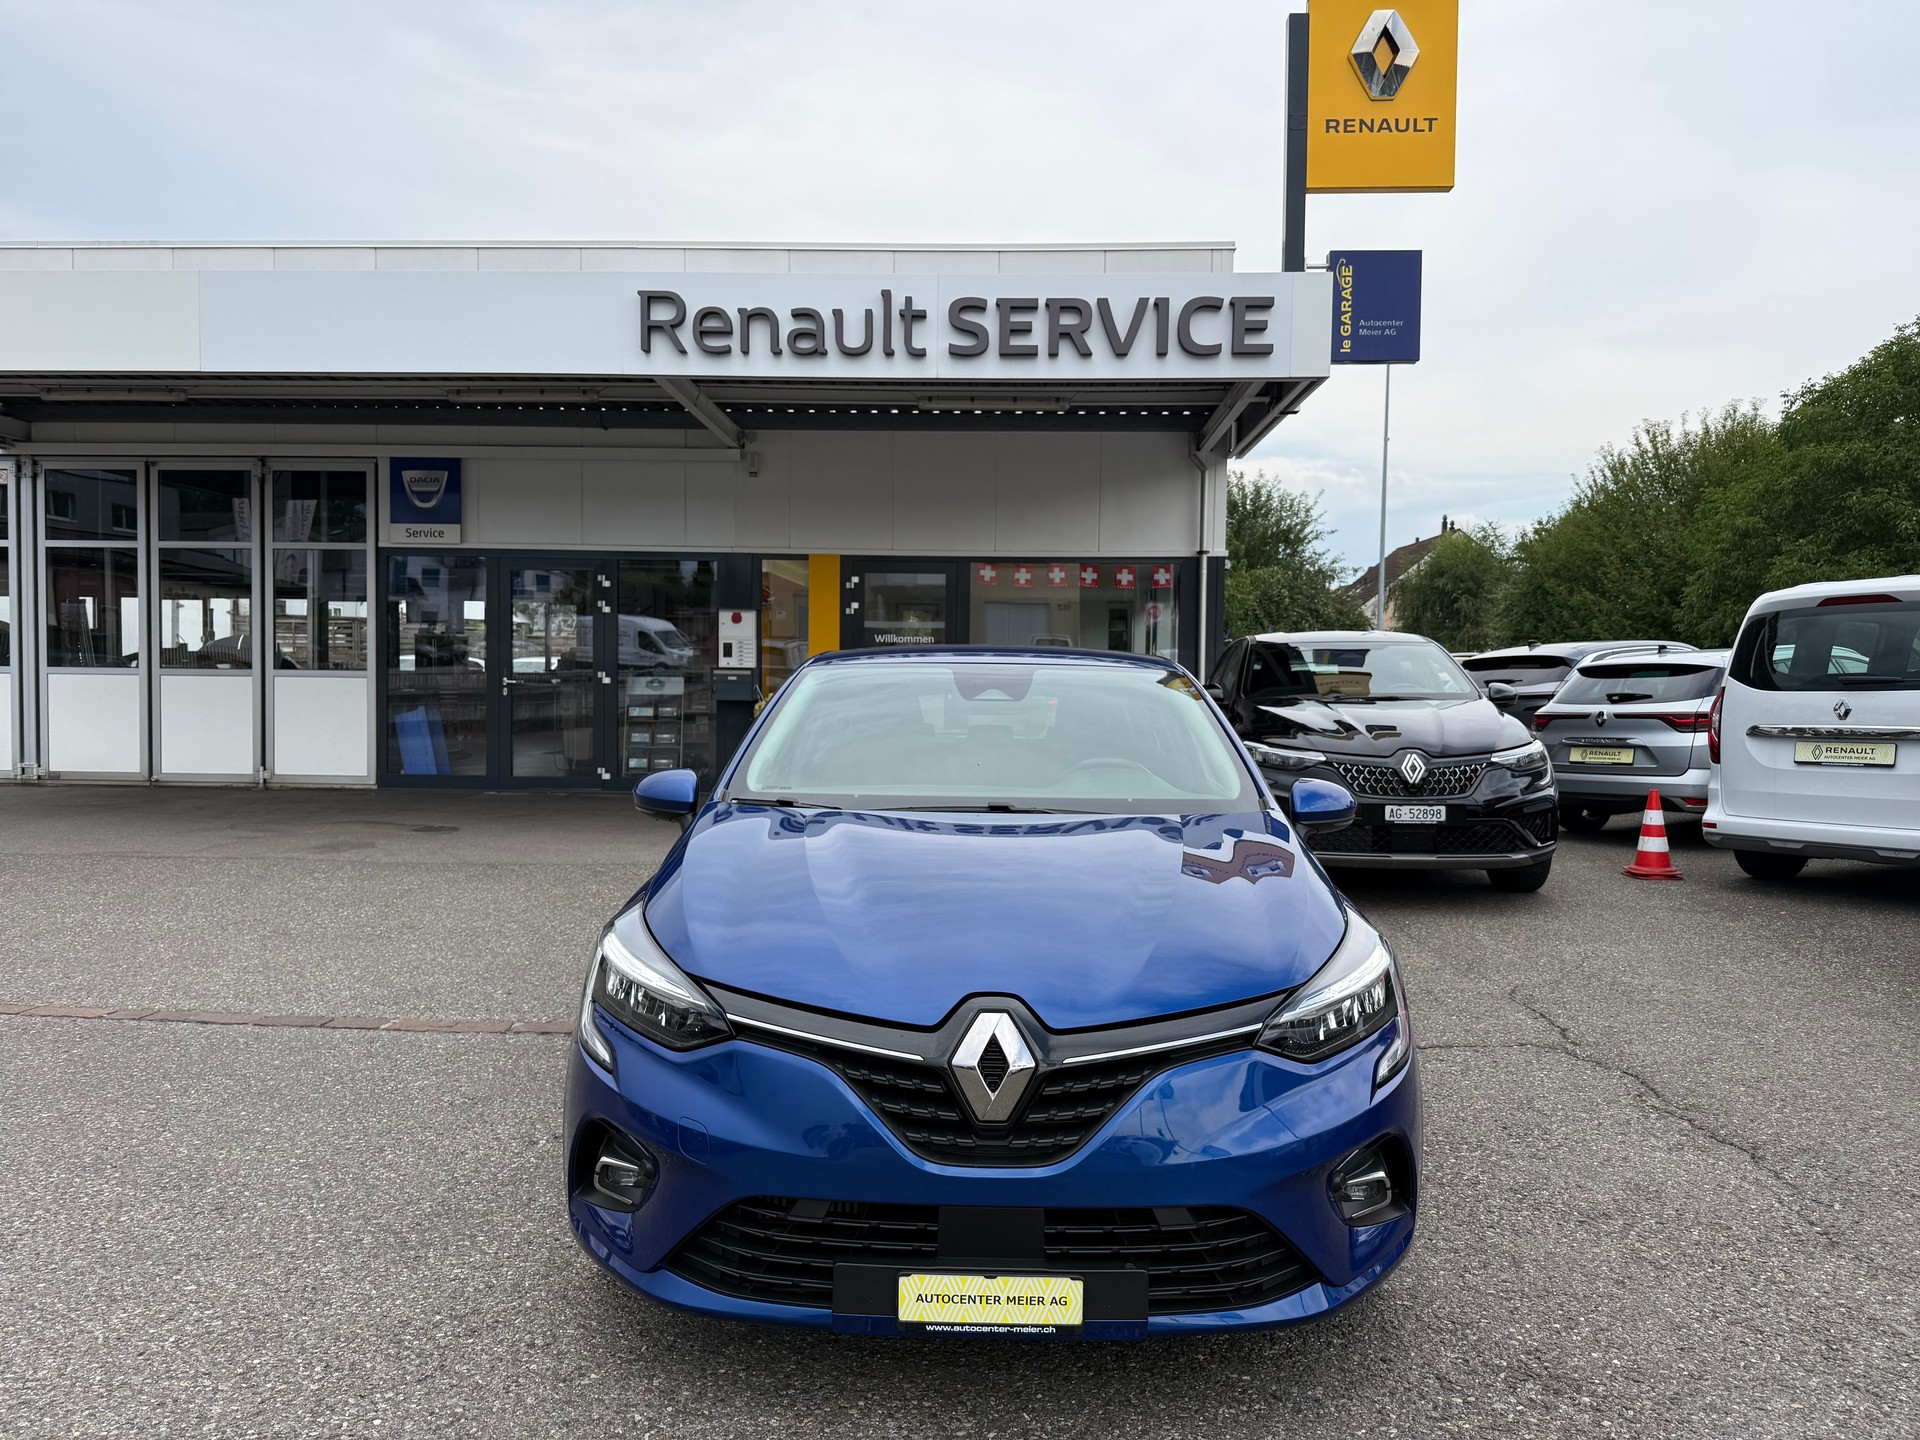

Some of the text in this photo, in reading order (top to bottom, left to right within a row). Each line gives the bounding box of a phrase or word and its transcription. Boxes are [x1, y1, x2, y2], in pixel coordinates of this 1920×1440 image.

[1325, 118, 1438, 133] RENAULT
[1340, 265, 1352, 353] le GARAGE
[637, 289, 1275, 357] Renault SERVICE
[405, 528, 445, 538] Service
[874, 634, 935, 643] Willkommen
[1825, 747, 1876, 755] RENAULT
[916, 1294, 1068, 1306] AUTOCENTER MEIER AG
[926, 1325, 1056, 1333] www.autocenter-meier.ch
